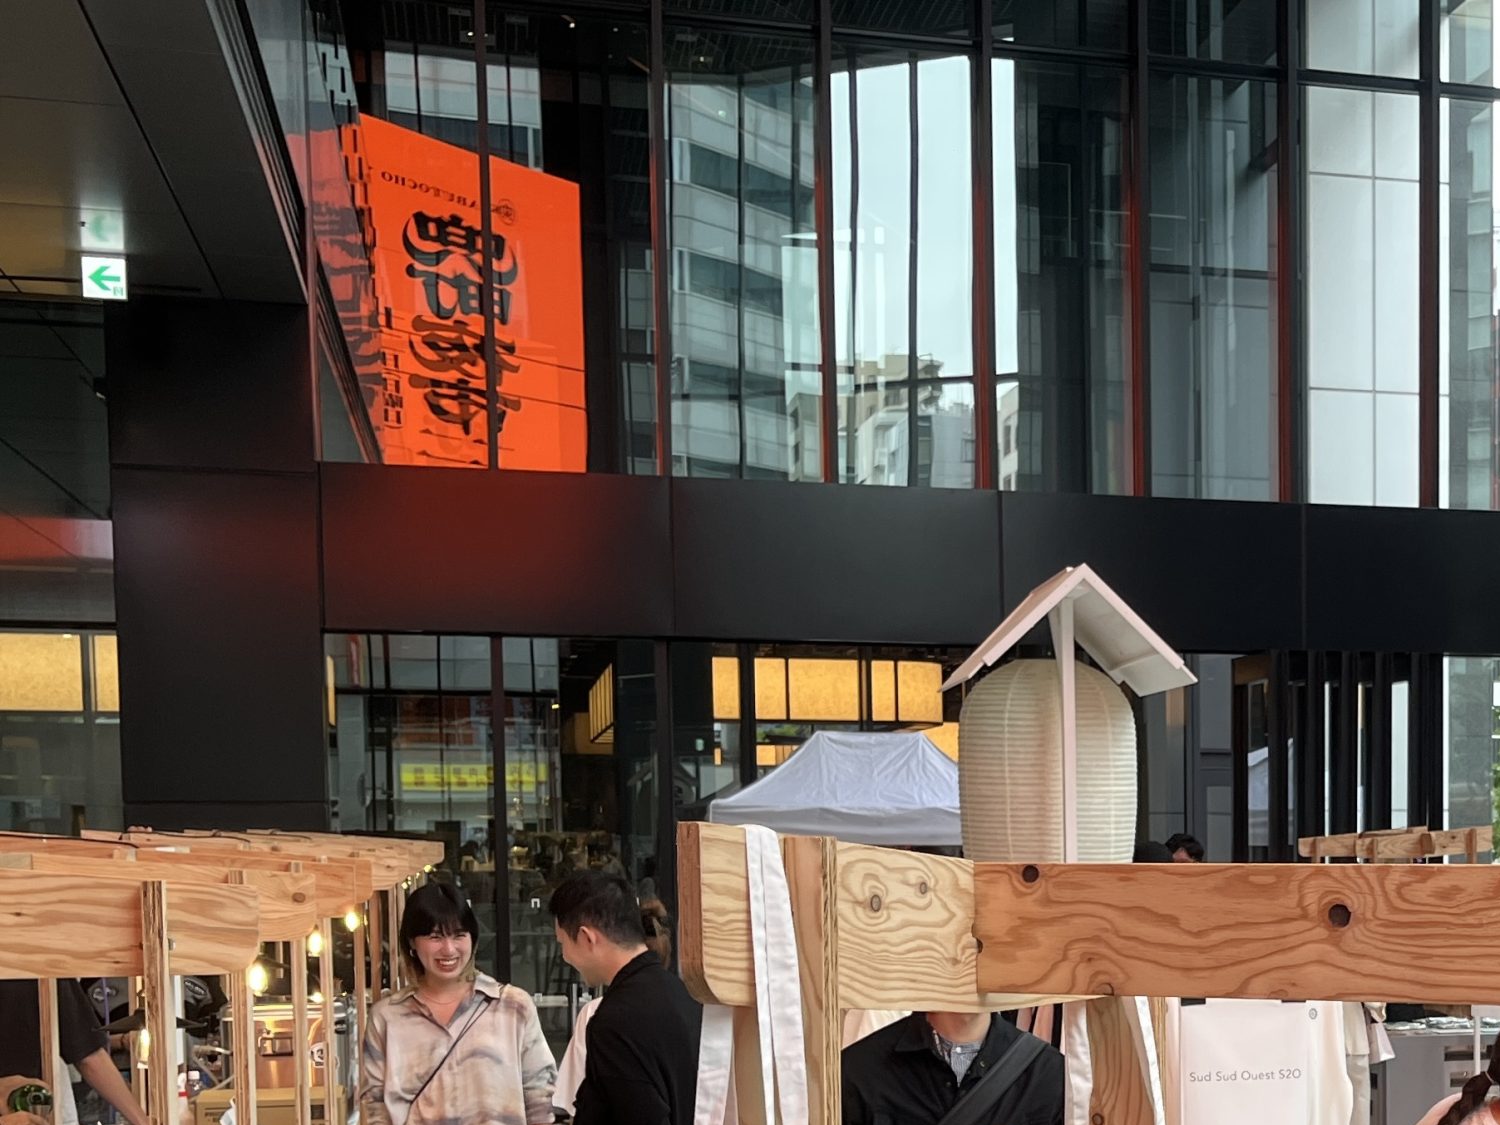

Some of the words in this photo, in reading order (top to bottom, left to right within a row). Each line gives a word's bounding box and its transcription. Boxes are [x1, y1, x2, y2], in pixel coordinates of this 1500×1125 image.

[1189, 1071, 1212, 1082] Sud
[1215, 1071, 1237, 1082] Sud
[1240, 1070, 1275, 1081] Ouest
